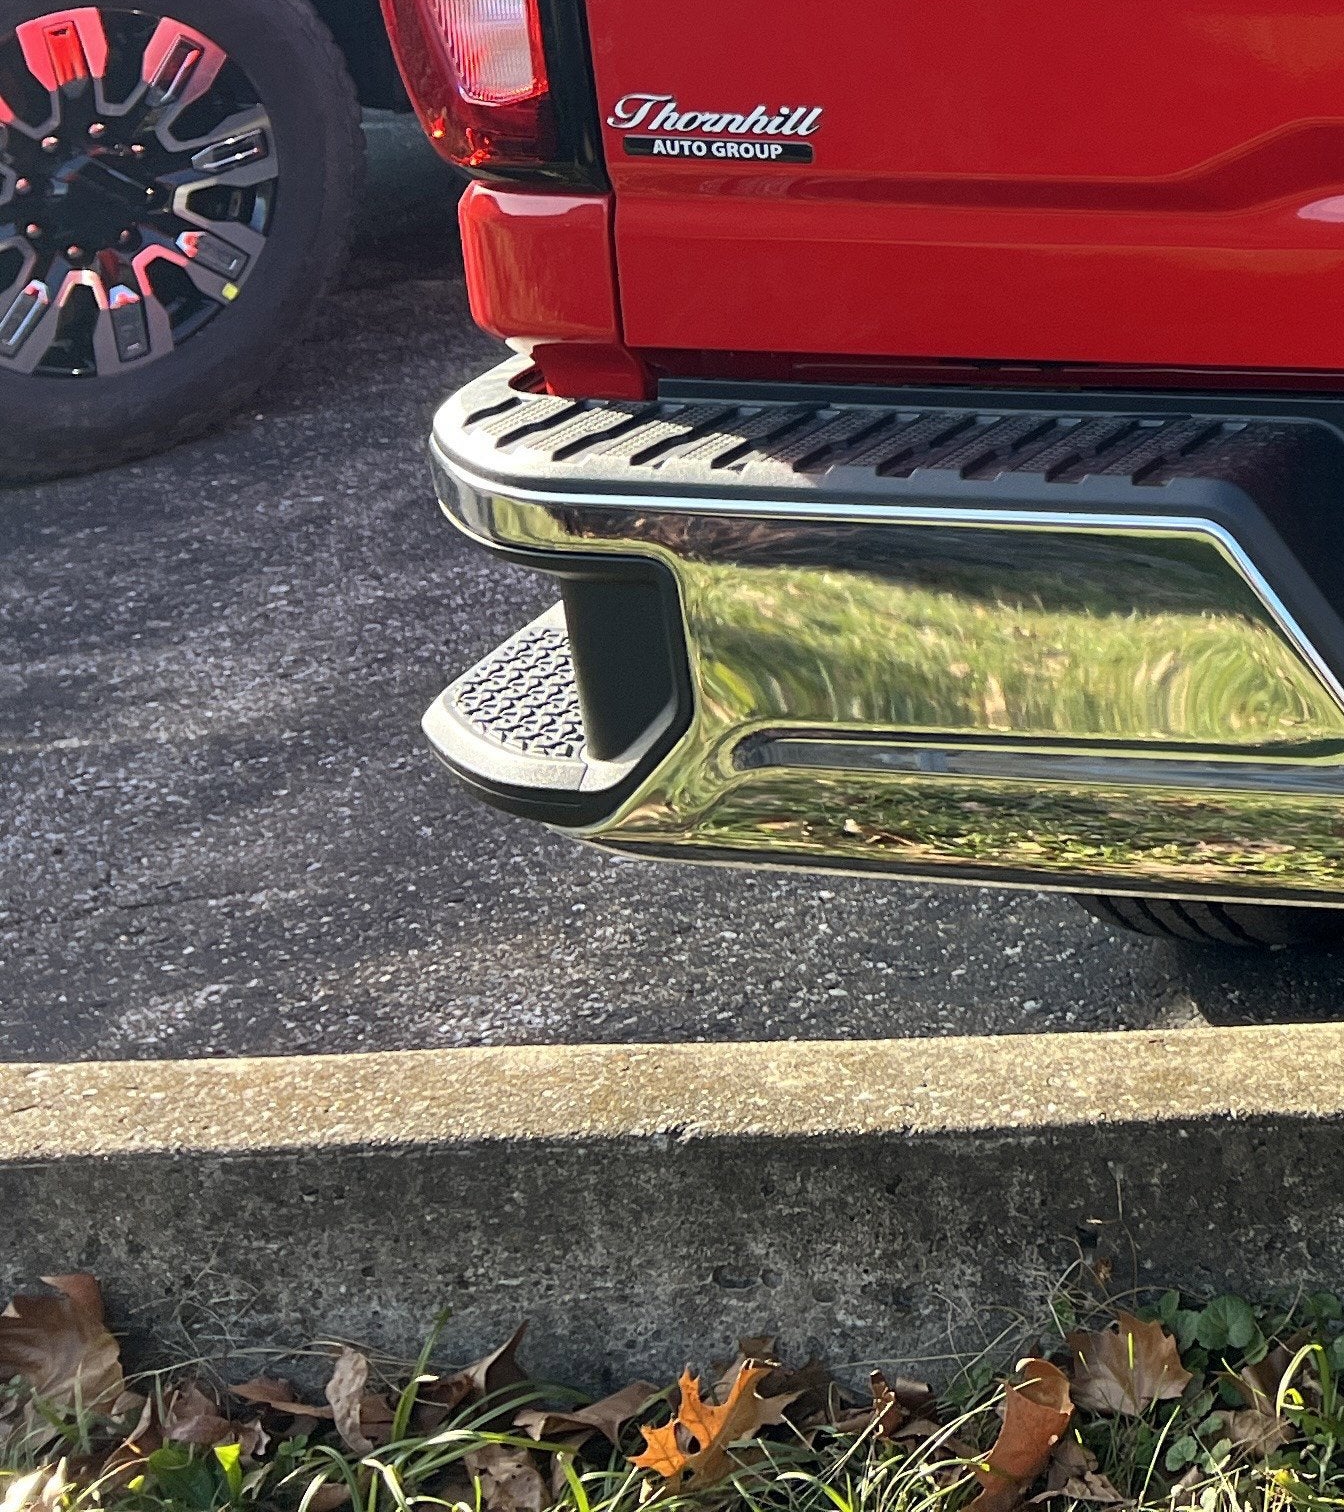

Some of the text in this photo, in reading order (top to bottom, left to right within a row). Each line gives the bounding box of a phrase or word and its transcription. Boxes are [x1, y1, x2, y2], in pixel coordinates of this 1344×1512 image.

[606, 93, 823, 136] Thornhill
[652, 140, 783, 159] AUTO GROUP
